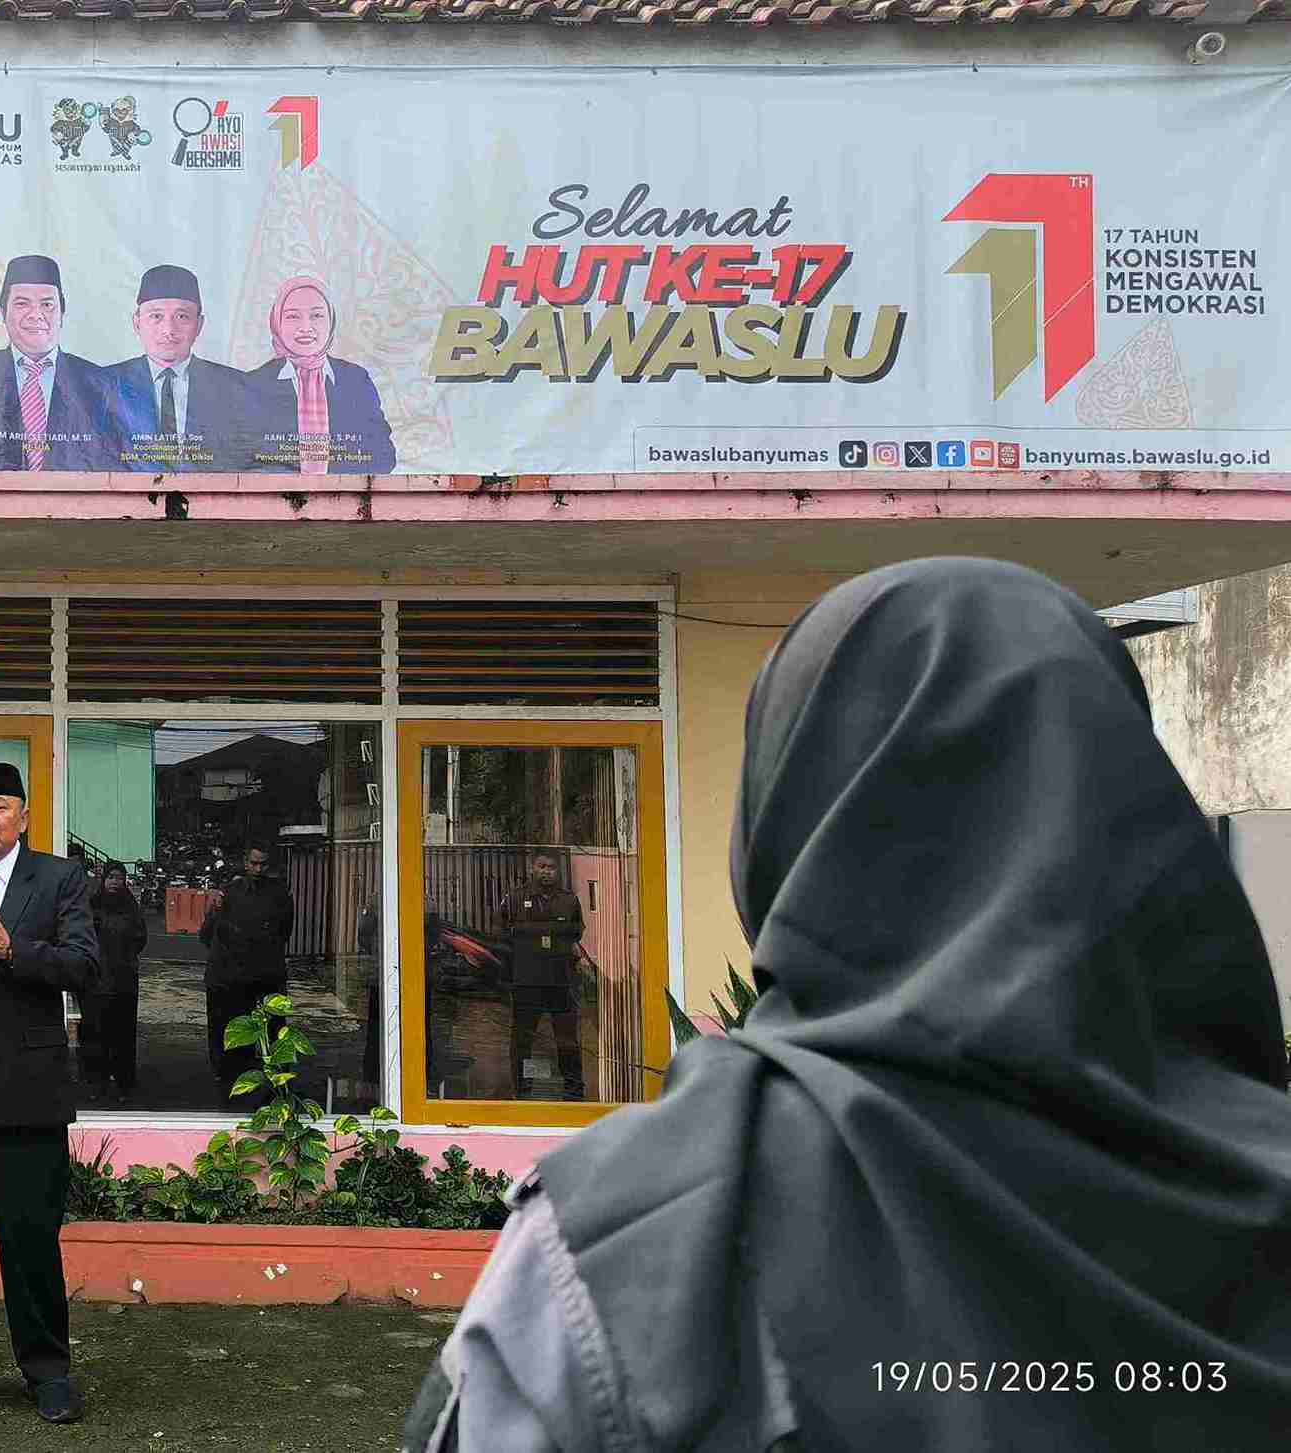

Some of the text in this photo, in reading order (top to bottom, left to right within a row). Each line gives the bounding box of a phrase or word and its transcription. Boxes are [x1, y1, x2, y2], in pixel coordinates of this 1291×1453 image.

[217, 116, 241, 133] AYO
[201, 134, 241, 150] AWASI
[186, 151, 241, 168] BERSAMA
[1069, 176, 1089, 188] TH
[532, 183, 793, 241] Selamat
[1104, 229, 1199, 244] 17 TAHUN
[1105, 249, 1257, 269] KONSISTEN
[477, 245, 853, 307] HUT KE-17
[1105, 272, 1262, 291] MENGAWAL
[1105, 295, 1265, 315] DEMOKRASI
[428, 305, 908, 383] BAWASLU
[648, 446, 829, 464] bawaslubanyumas
[1025, 448, 1271, 467] banyumas.bawaslu.go.id
